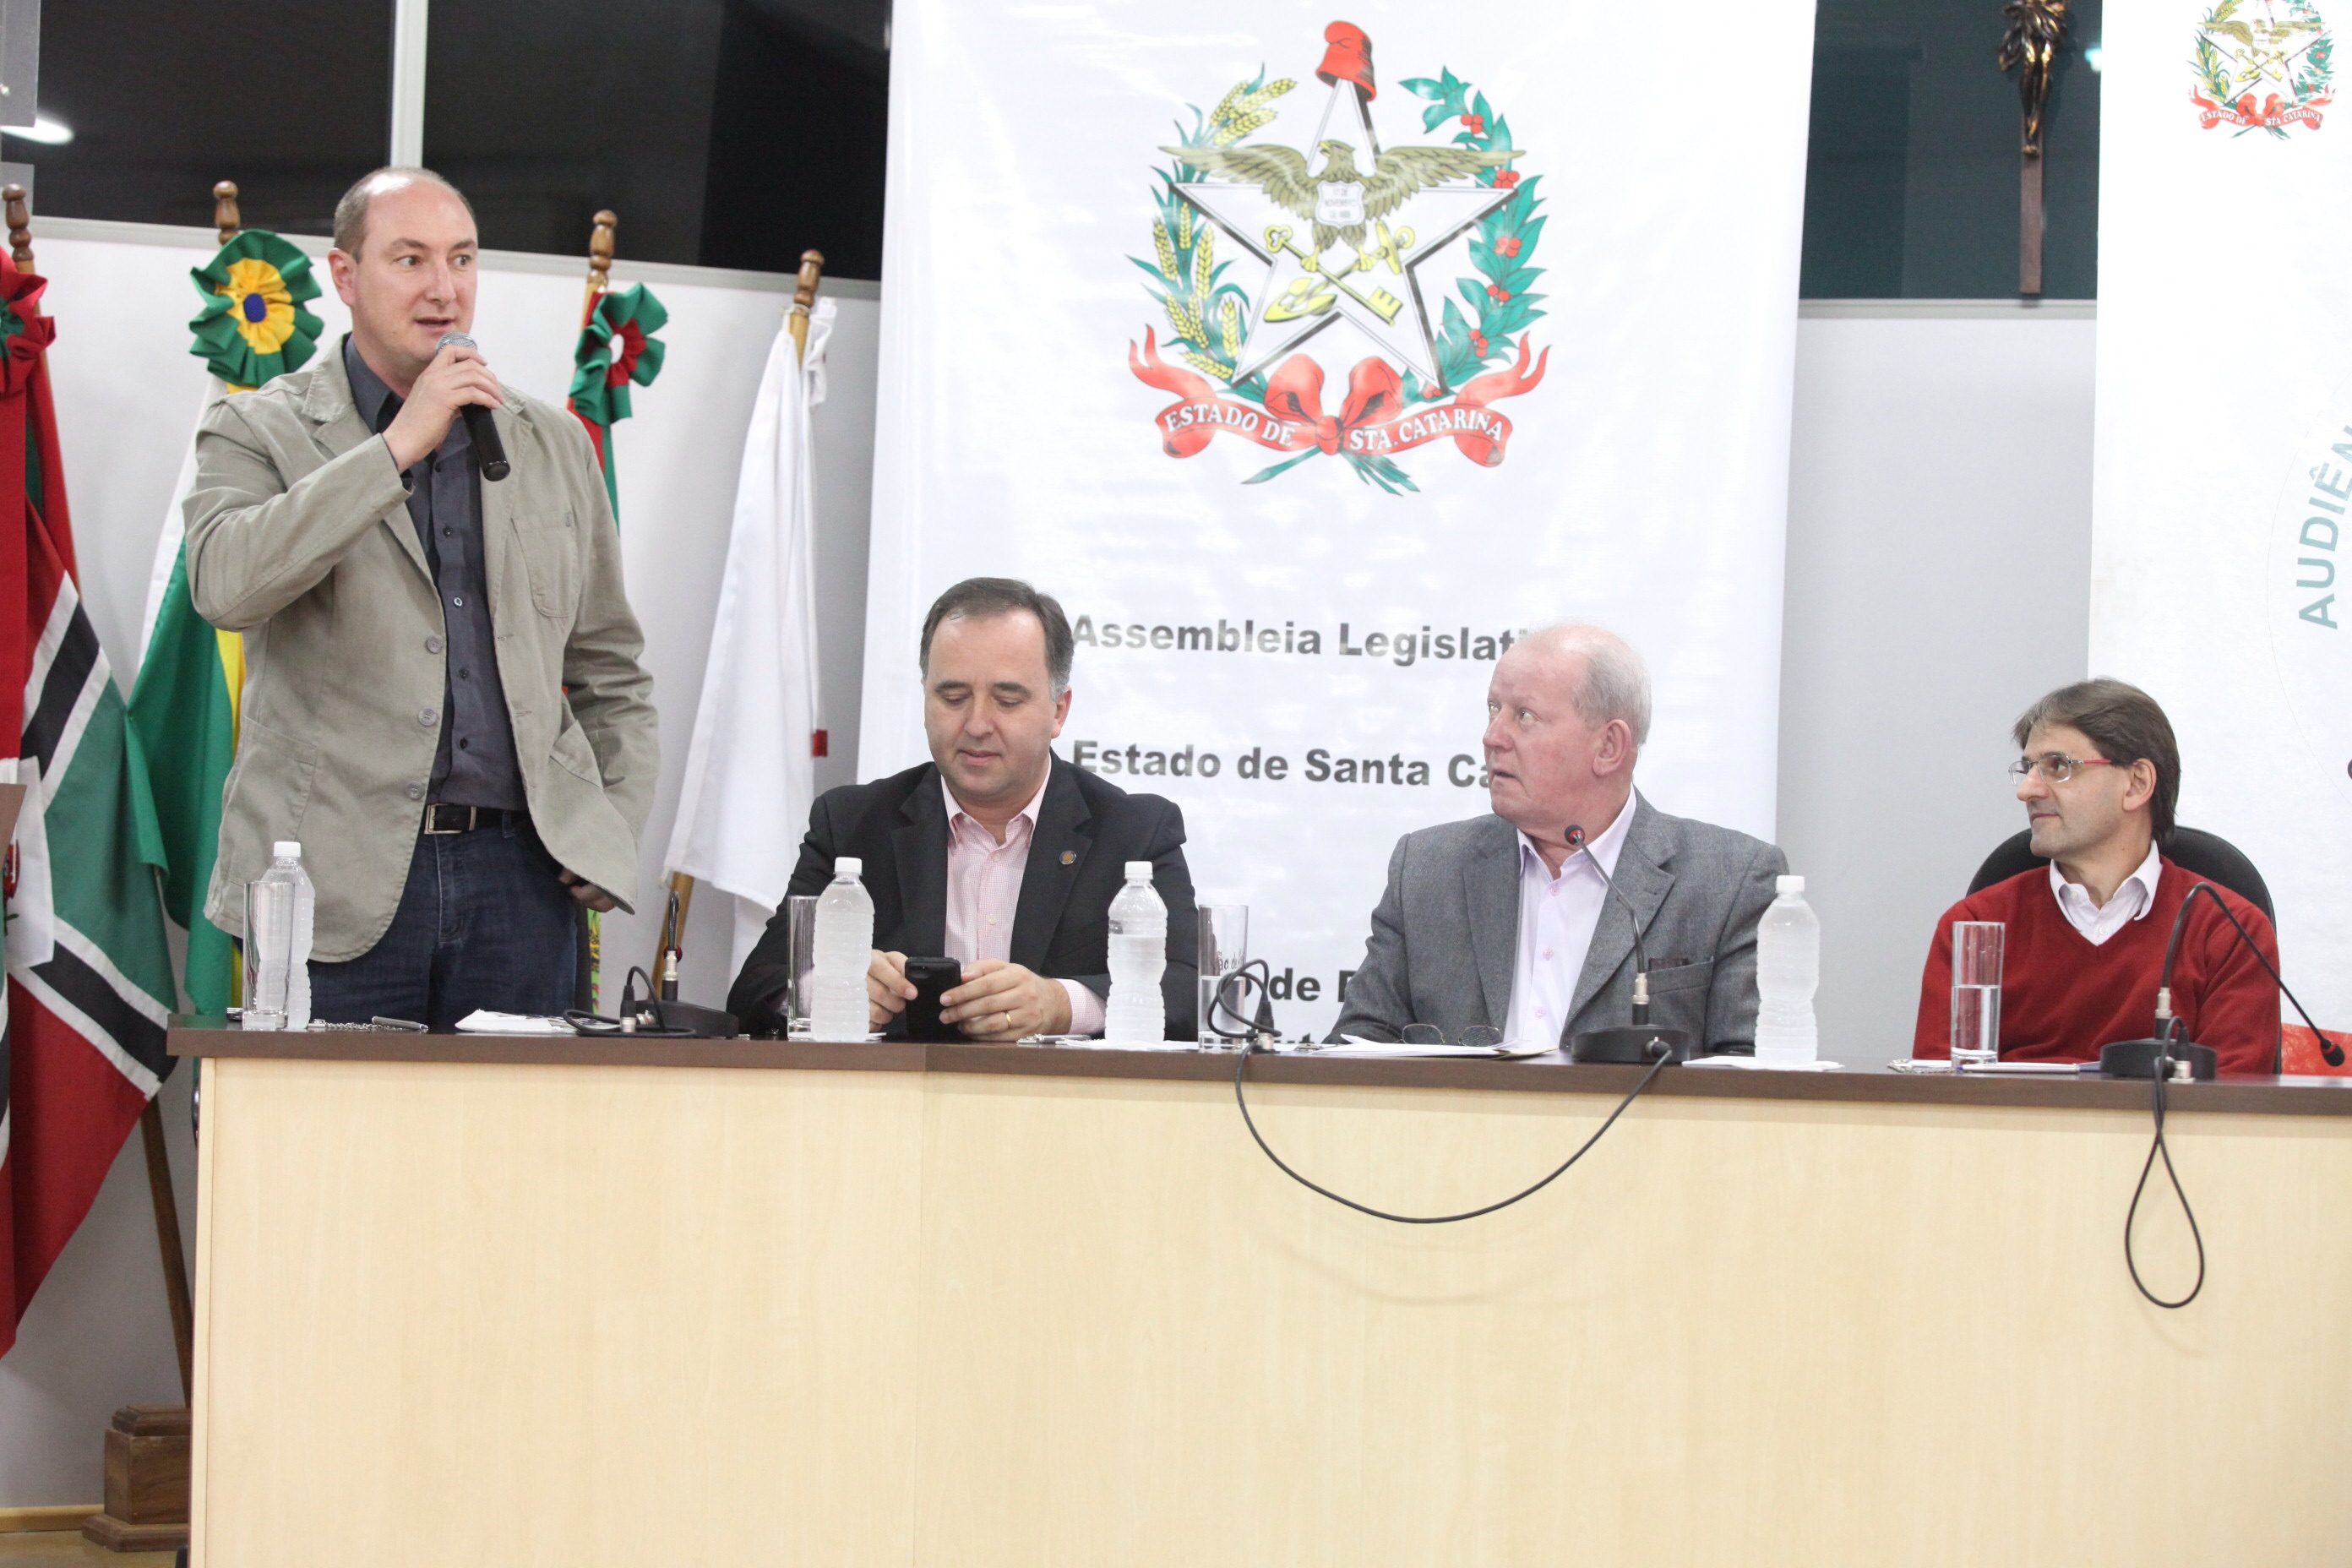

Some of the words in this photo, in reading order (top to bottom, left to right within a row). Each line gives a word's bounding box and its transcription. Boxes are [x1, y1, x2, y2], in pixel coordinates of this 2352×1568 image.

[2201, 110, 2235, 122] ESTADO
[2235, 115, 2249, 125] DE
[2283, 110, 2320, 122] CATARINA
[1163, 403, 1259, 433] ESTADO
[1260, 421, 1295, 447] DE
[1349, 428, 1398, 450] STA.
[1398, 408, 1503, 444] CATARINA
[1072, 614, 1321, 655] Assembleia
[1339, 623, 1527, 667] Legislat
[1073, 740, 1220, 777] Estado
[1237, 747, 1288, 780] de
[1305, 749, 1429, 786] Santa
[1269, 967, 1320, 1001] de
